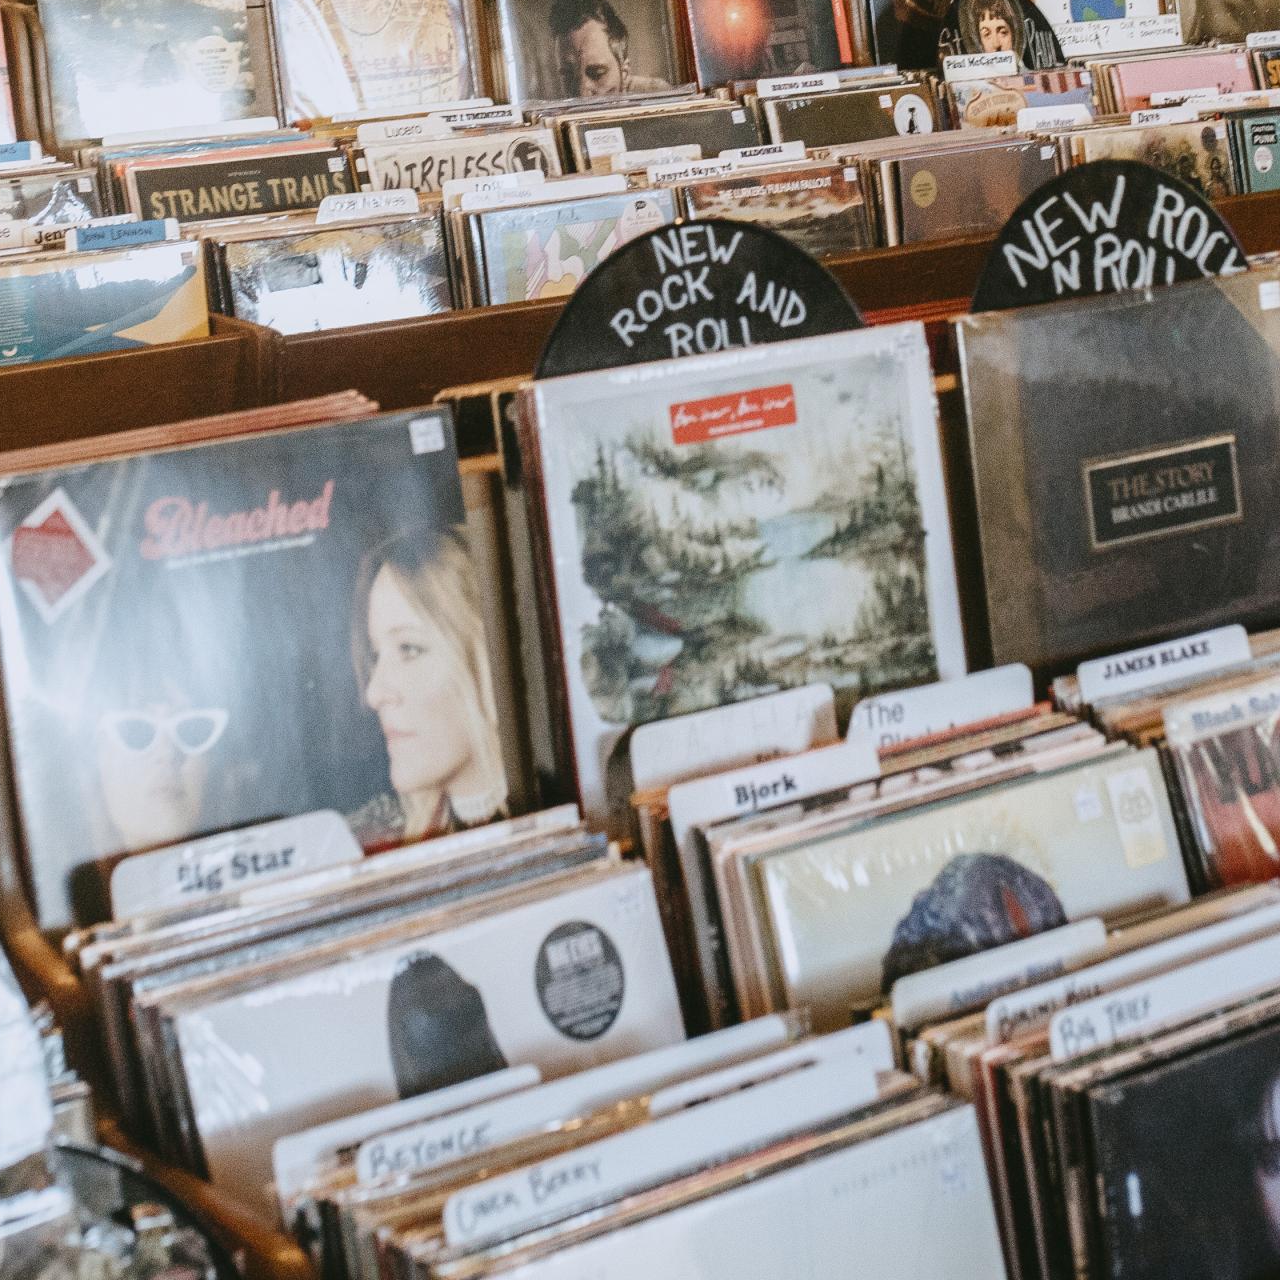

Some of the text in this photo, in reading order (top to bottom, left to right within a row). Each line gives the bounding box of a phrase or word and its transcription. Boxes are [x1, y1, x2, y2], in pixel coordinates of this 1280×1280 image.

[384, 148, 506, 193] WIRELESS
[150, 180, 263, 220] STRANGE
[265, 172, 349, 206] TRAILS
[650, 224, 744, 274] NEW
[1001, 176, 1250, 289] NEW ROCK
[608, 264, 807, 349] ROCK AND
[664, 315, 752, 359] ROLL
[1107, 460, 1217, 499] THE STORY
[140, 481, 337, 560] Bleached
[1104, 639, 1213, 681] JAMES BLAKE
[863, 699, 905, 729] The
[734, 773, 798, 808] Bjork
[230, 846, 298, 880] Star
[368, 1120, 492, 1180] BEYONCE
[528, 1155, 605, 1207] BERRY
